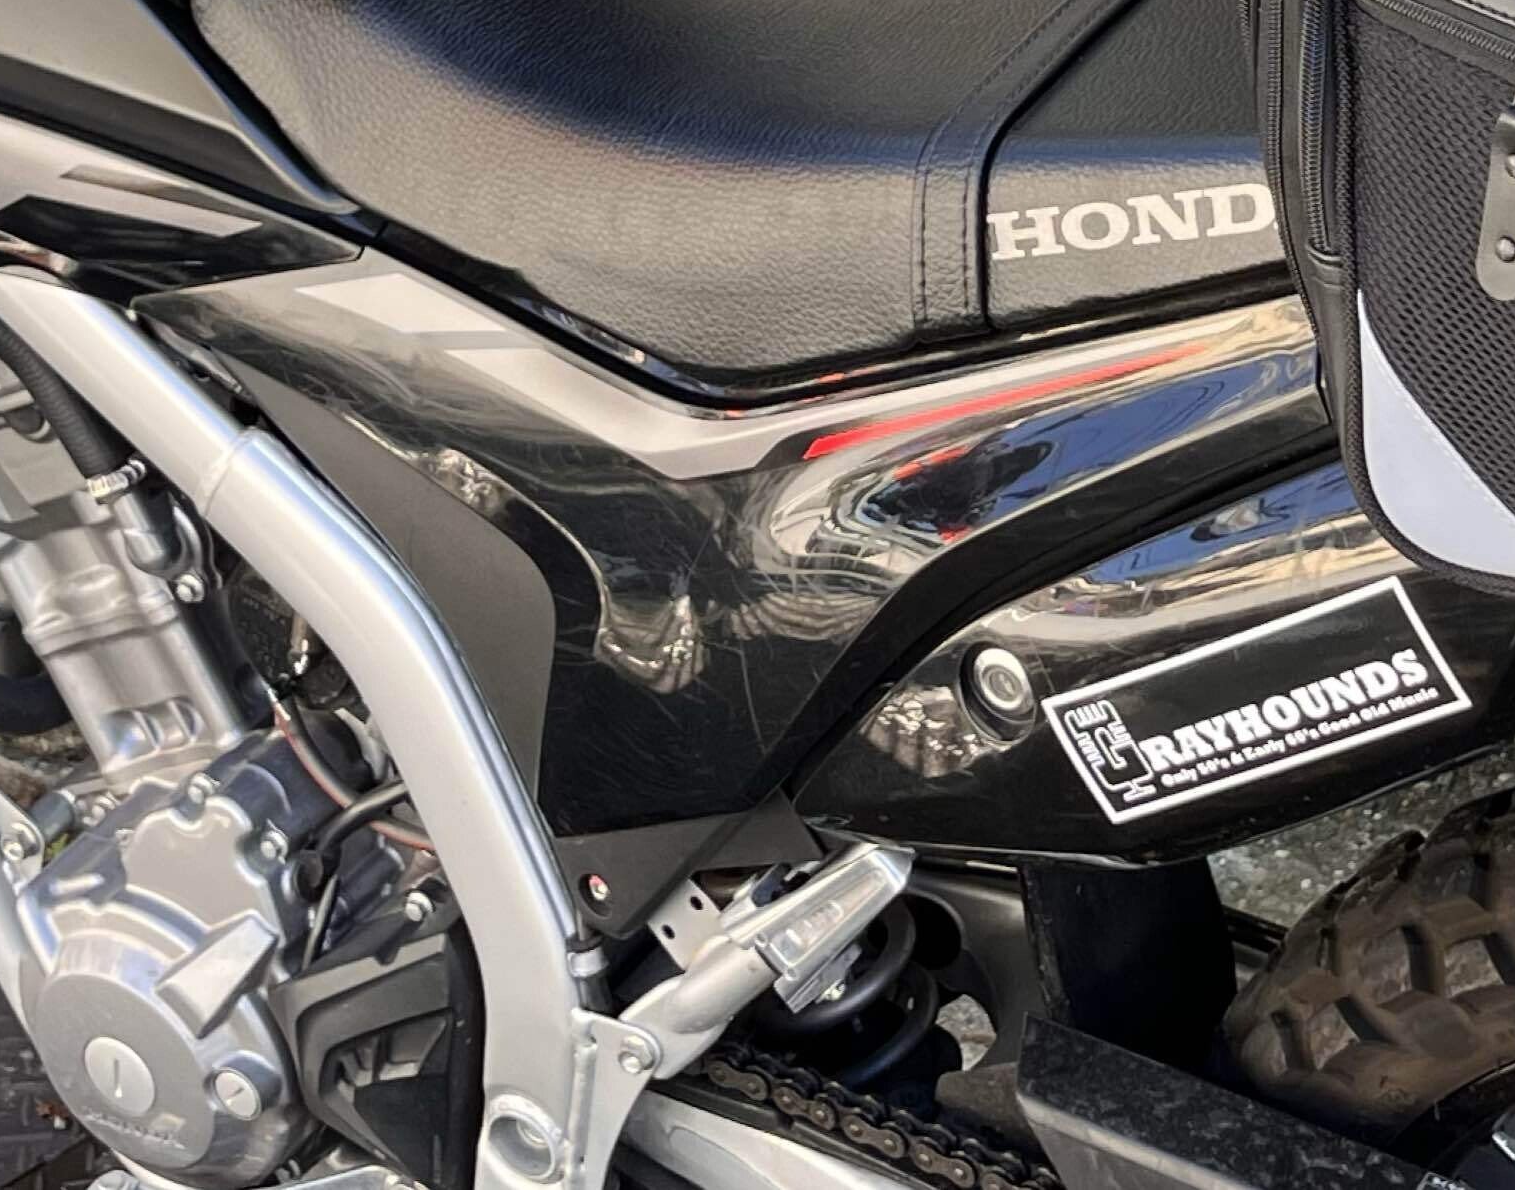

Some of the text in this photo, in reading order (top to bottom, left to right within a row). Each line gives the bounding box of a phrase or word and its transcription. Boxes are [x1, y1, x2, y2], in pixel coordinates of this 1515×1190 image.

[987, 183, 1279, 260] HOND
[1160, 768, 1197, 786] Only
[1230, 751, 1244, 764] &
[1241, 739, 1285, 760] Early
[1317, 712, 1361, 735] Good
[1359, 702, 1390, 721] Old
[1387, 687, 1438, 711] Music
